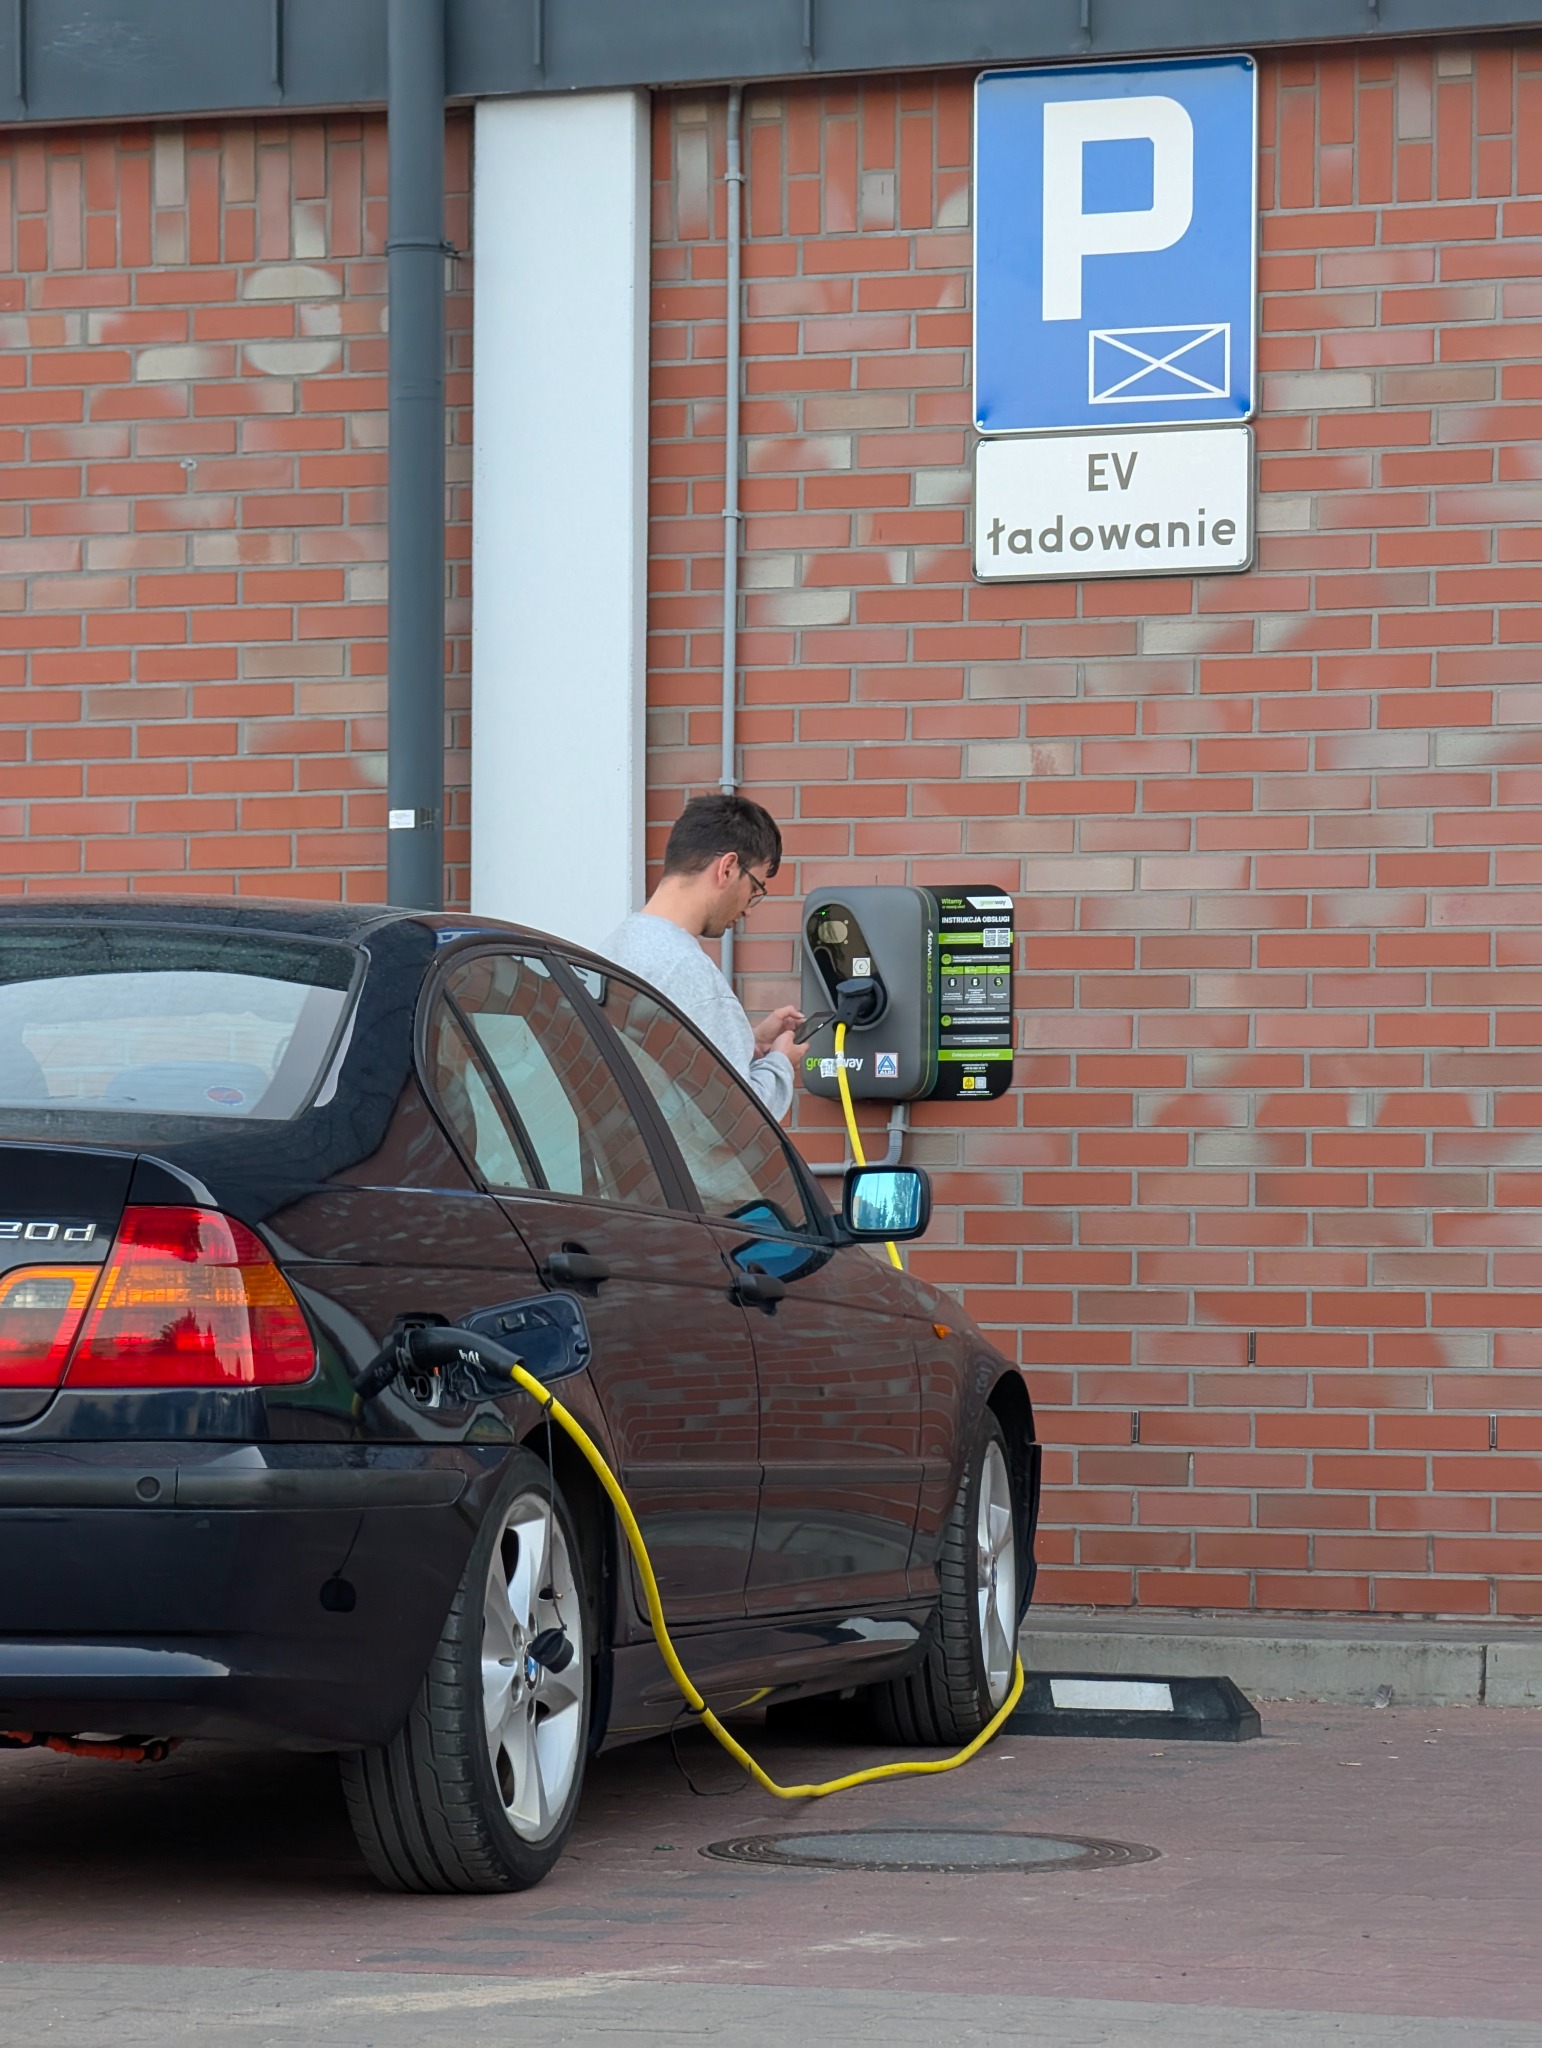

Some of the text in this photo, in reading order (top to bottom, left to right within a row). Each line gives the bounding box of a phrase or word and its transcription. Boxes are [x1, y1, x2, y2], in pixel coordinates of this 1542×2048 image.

[1042, 95, 1194, 322] P
[1088, 451, 1138, 492] EV
[986, 508, 1236, 556] ładowanie
